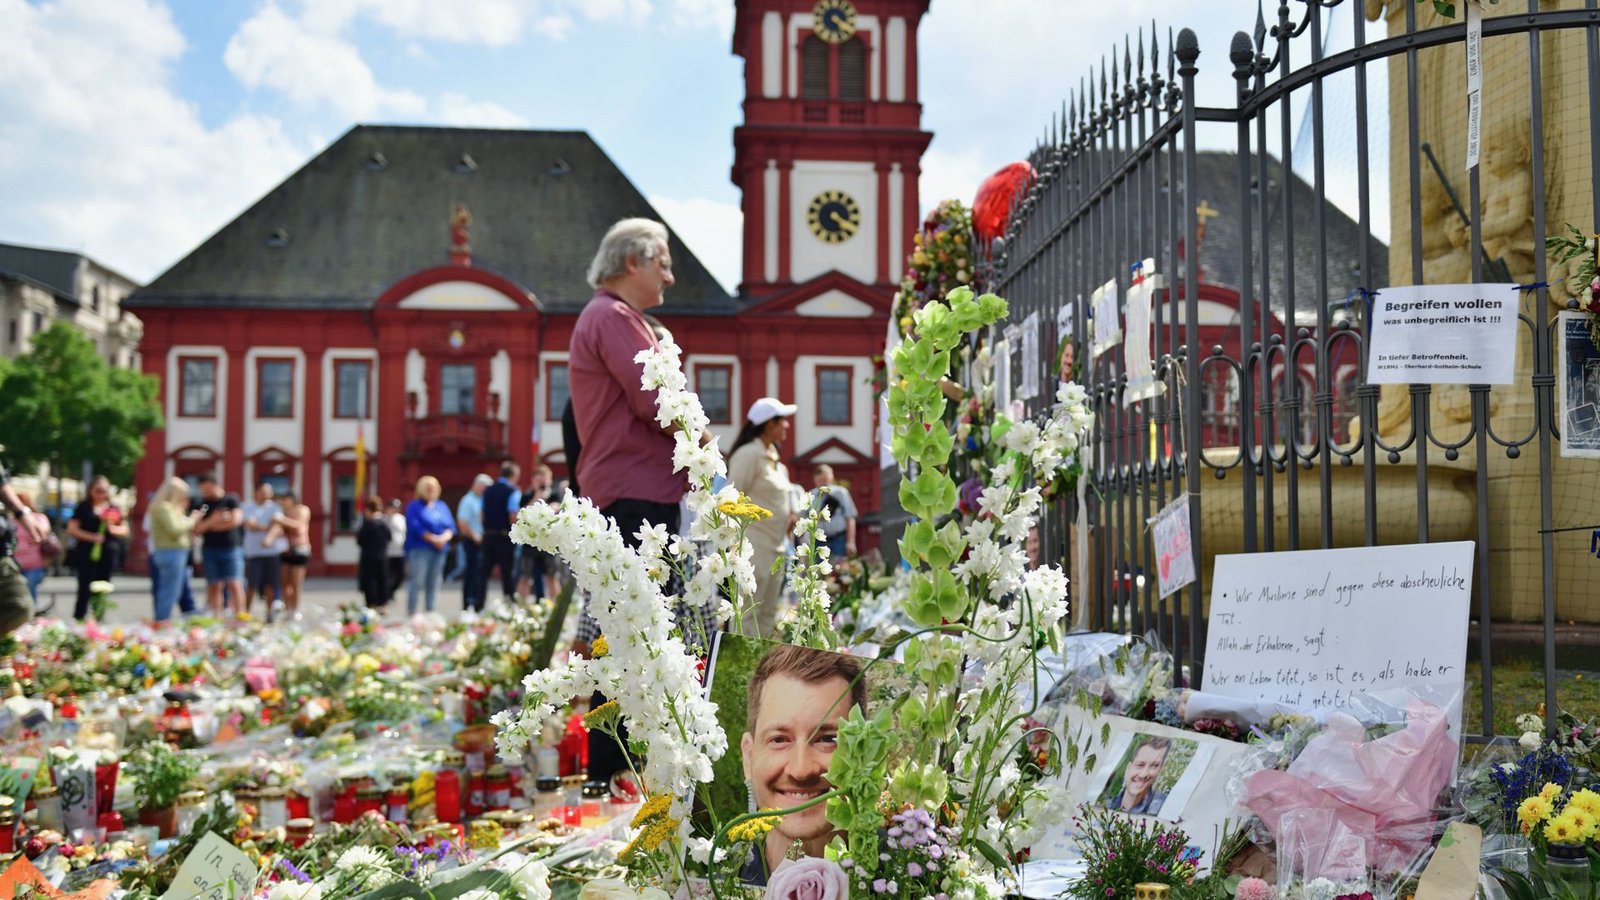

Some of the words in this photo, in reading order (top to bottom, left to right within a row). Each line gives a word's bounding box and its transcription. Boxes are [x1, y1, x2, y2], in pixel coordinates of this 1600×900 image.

[1385, 299, 1450, 313] Begreifen
[1454, 298, 1502, 309] wollen
[1404, 315, 1471, 325] unbegreiflich
[1473, 315, 1487, 324] ist
[1489, 315, 1501, 324] !!!
[1388, 353, 1410, 361] tiefer
[1411, 353, 1469, 361] Betroffenheit.
[1235, 587, 1253, 604] Wir
[1257, 584, 1297, 603] Muslime
[1303, 571, 1331, 600] sind
[1334, 583, 1364, 607] gegen
[1399, 565, 1465, 590] abscheuliche
[1255, 634, 1300, 654] Erhabene,
[1303, 627, 1325, 656] sagt
[1249, 669, 1272, 685] Leben
[1308, 671, 1318, 682] so
[1326, 664, 1344, 684] ist
[1405, 658, 1431, 677] habe
[1438, 665, 1454, 675] er
[204, 845, 223, 868] In
[193, 875, 209, 892] an
